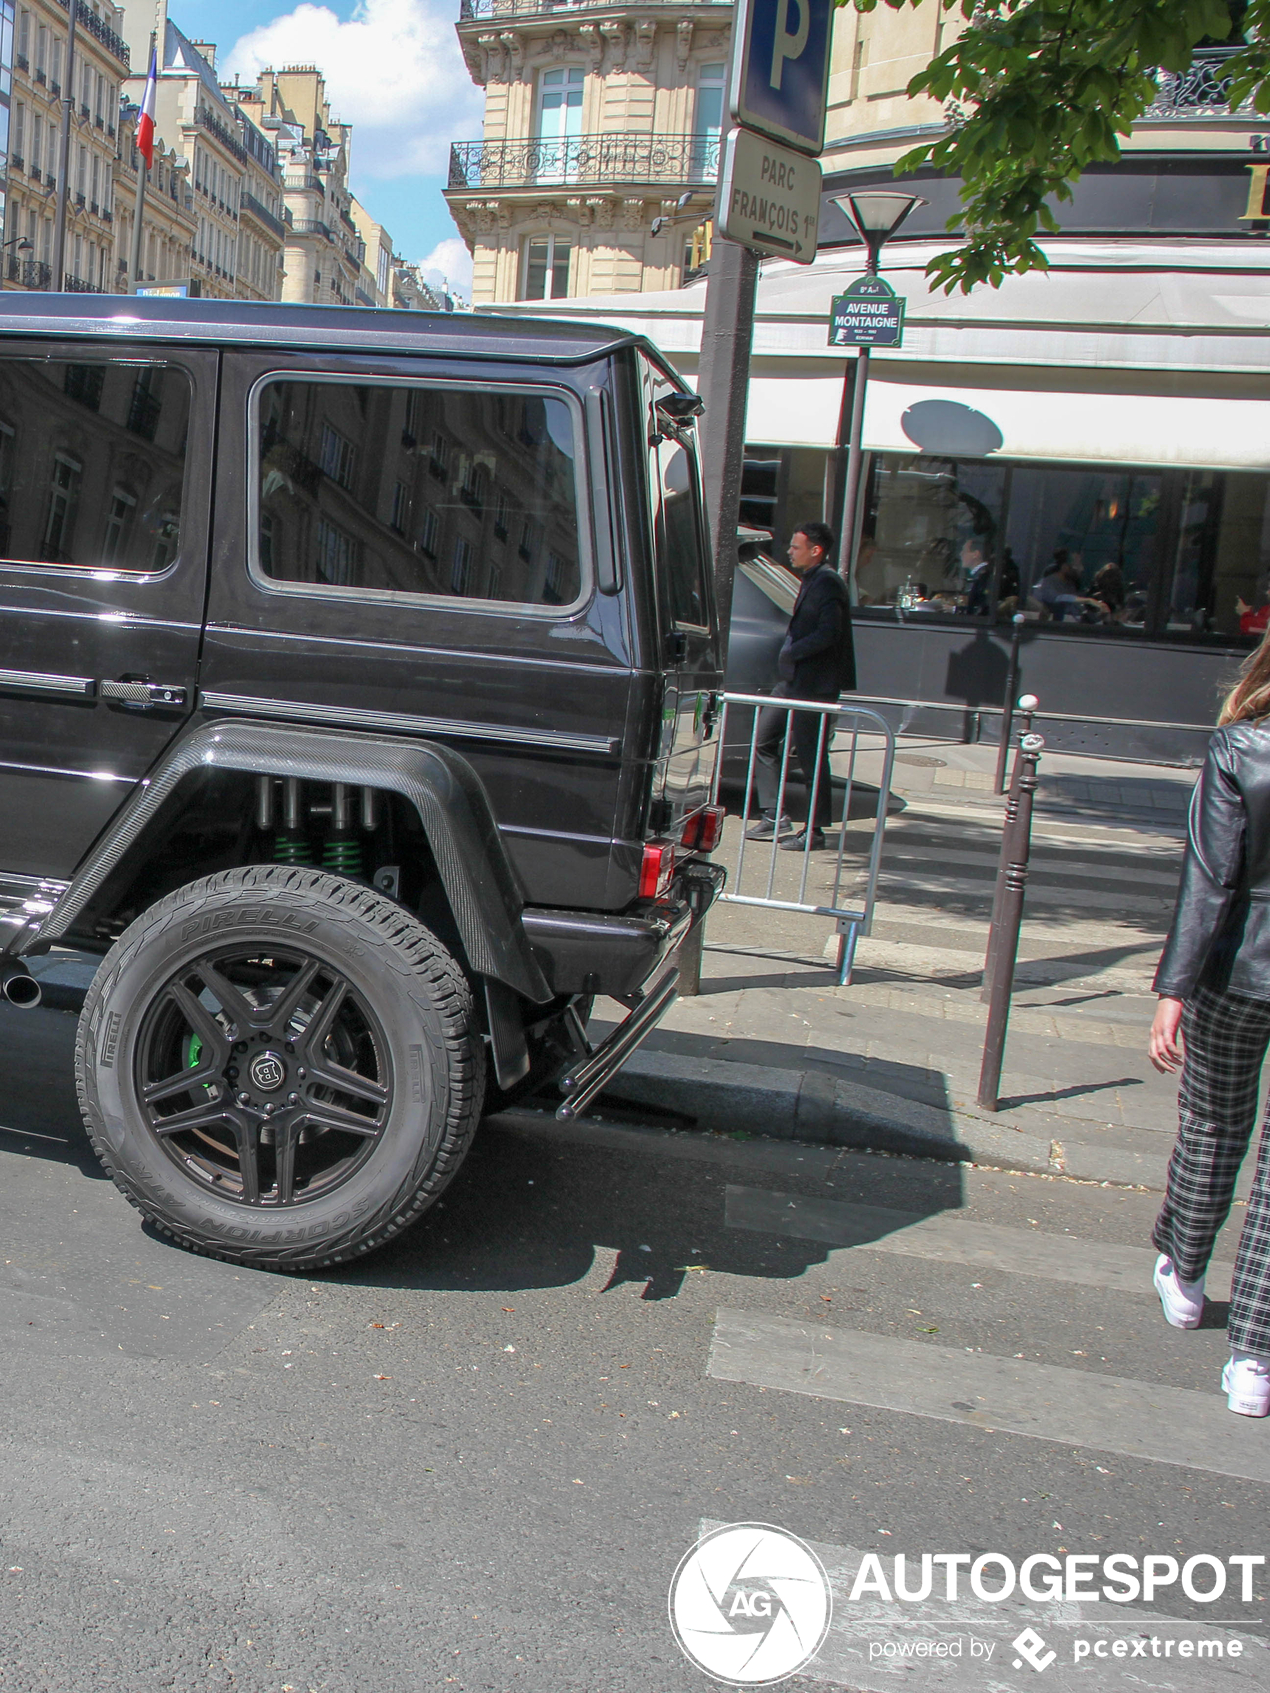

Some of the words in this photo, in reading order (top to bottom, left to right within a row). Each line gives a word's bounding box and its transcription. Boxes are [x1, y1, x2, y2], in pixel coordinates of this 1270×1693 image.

[769, 0, 810, 90] P
[761, 155, 796, 191] PARC
[732, 189, 799, 235] FRANÇOIS
[834, 316, 898, 328] MONTAIGNE
[846, 303, 889, 315] AVENUE
[181, 907, 320, 942] PIRELLI
[100, 1010, 122, 1069] PIRELLI
[129, 1159, 187, 1208] ATR
[199, 1197, 370, 1244] SCORPION
